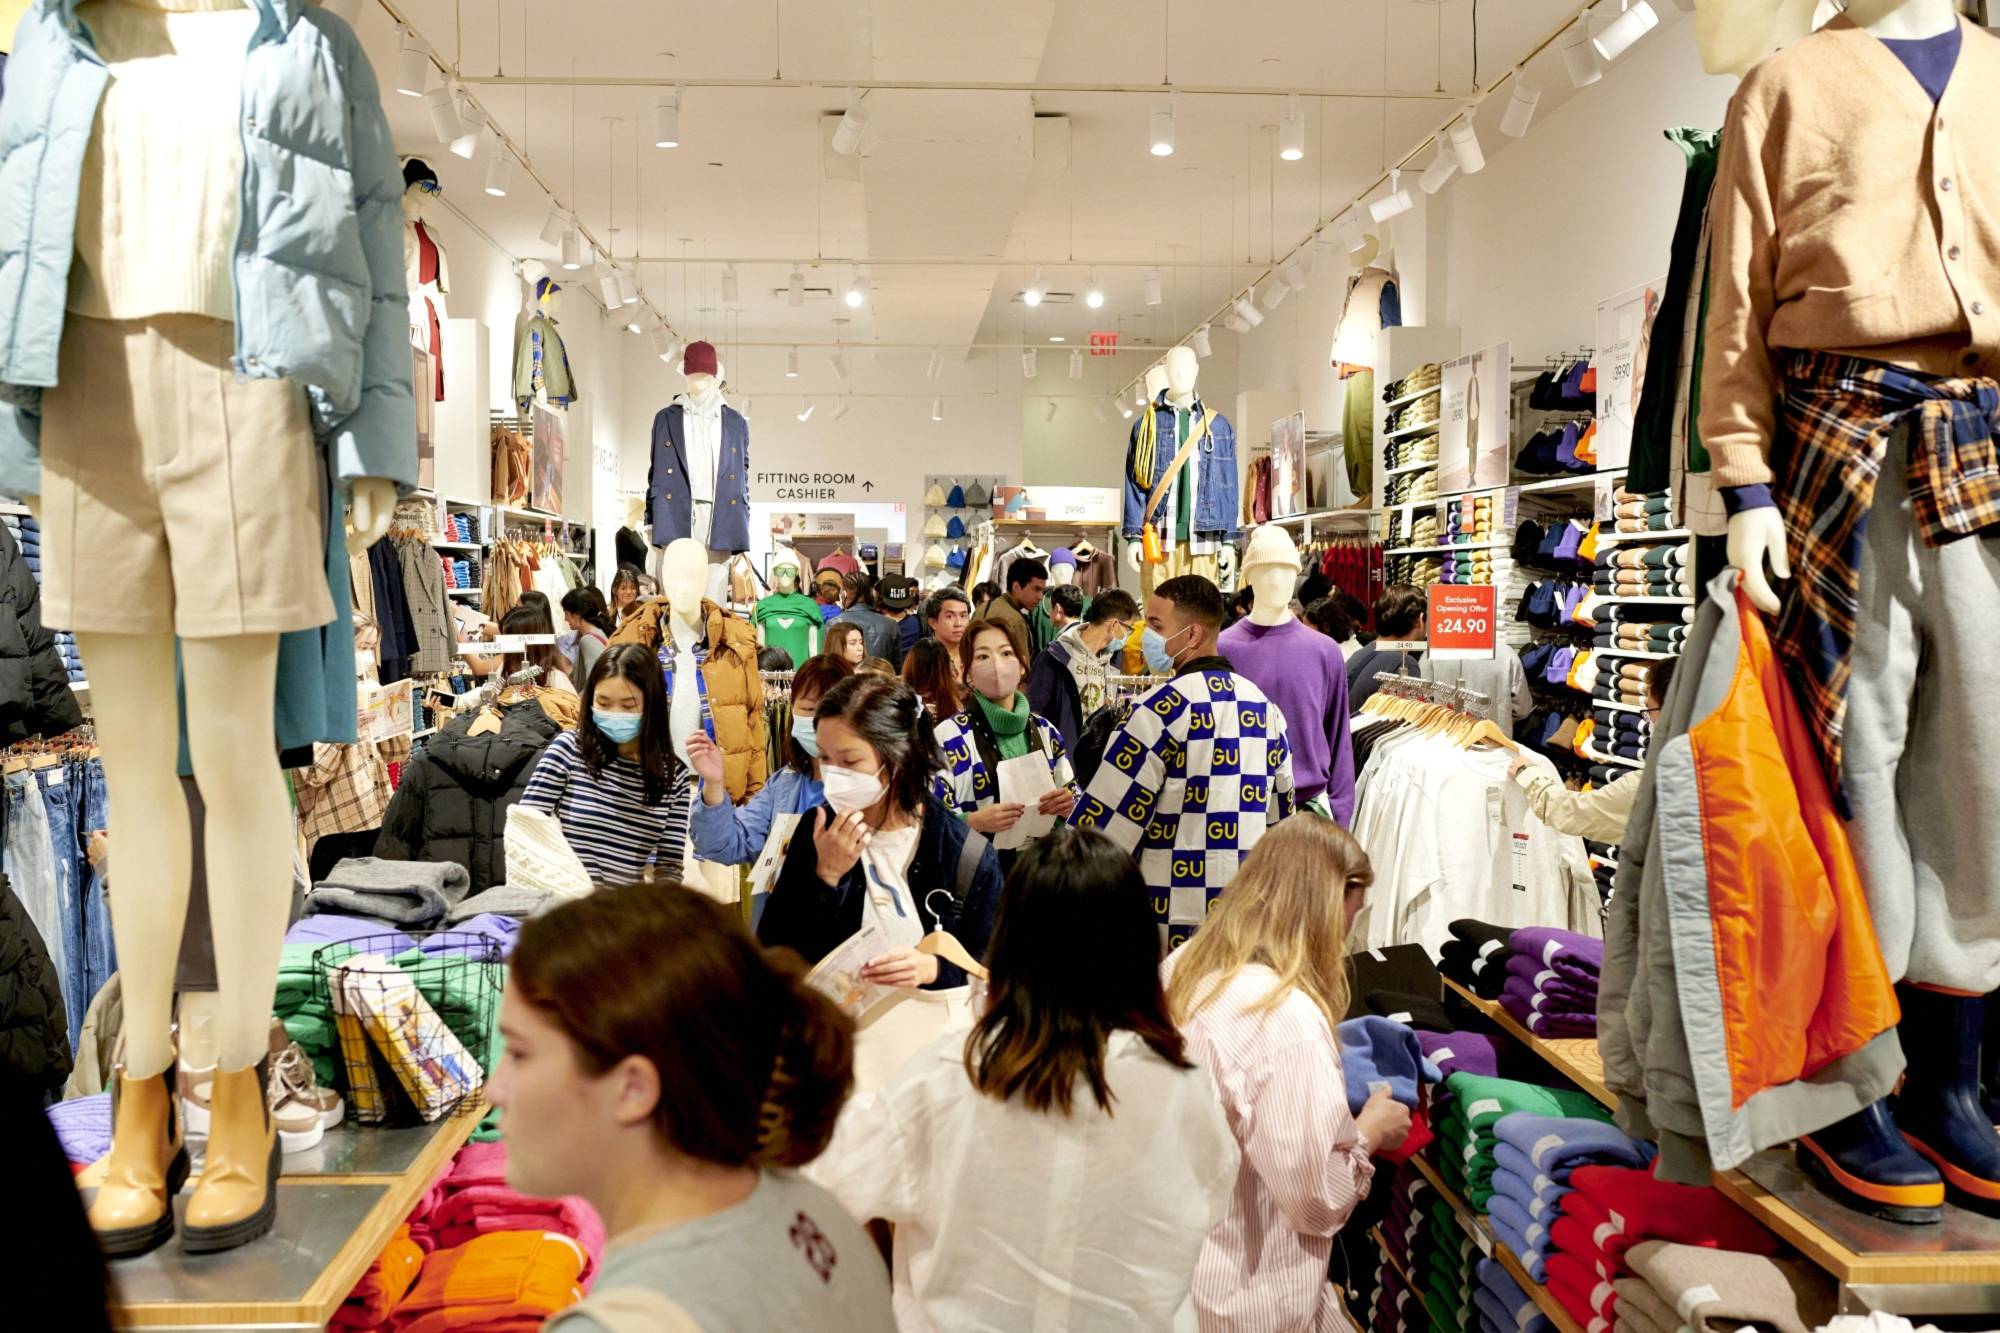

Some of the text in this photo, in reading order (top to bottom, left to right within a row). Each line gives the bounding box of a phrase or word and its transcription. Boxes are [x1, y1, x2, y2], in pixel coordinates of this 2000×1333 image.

[1090, 334, 1118, 355] EXIT
[757, 472, 855, 484] FITTING ROOM
[776, 488, 835, 499] CASHIER
[1436, 605, 1467, 614] Opening
[1437, 618, 1486, 634] $24.90
[1208, 676, 1235, 692] GU
[1154, 690, 1182, 715] GU
[1190, 713, 1214, 730] GU
[1240, 710, 1266, 728] GU
[1116, 737, 1141, 769] GU
[1213, 748, 1239, 766] GU
[1184, 786, 1209, 804] GU
[1242, 784, 1267, 803] GU
[1128, 788, 1154, 821] GU
[1078, 799, 1104, 829] GU
[1148, 822, 1177, 840] GU
[1208, 821, 1237, 840] GU
[1173, 860, 1203, 878] GU
[1154, 896, 1168, 914] U
[1170, 934, 1188, 951] G
